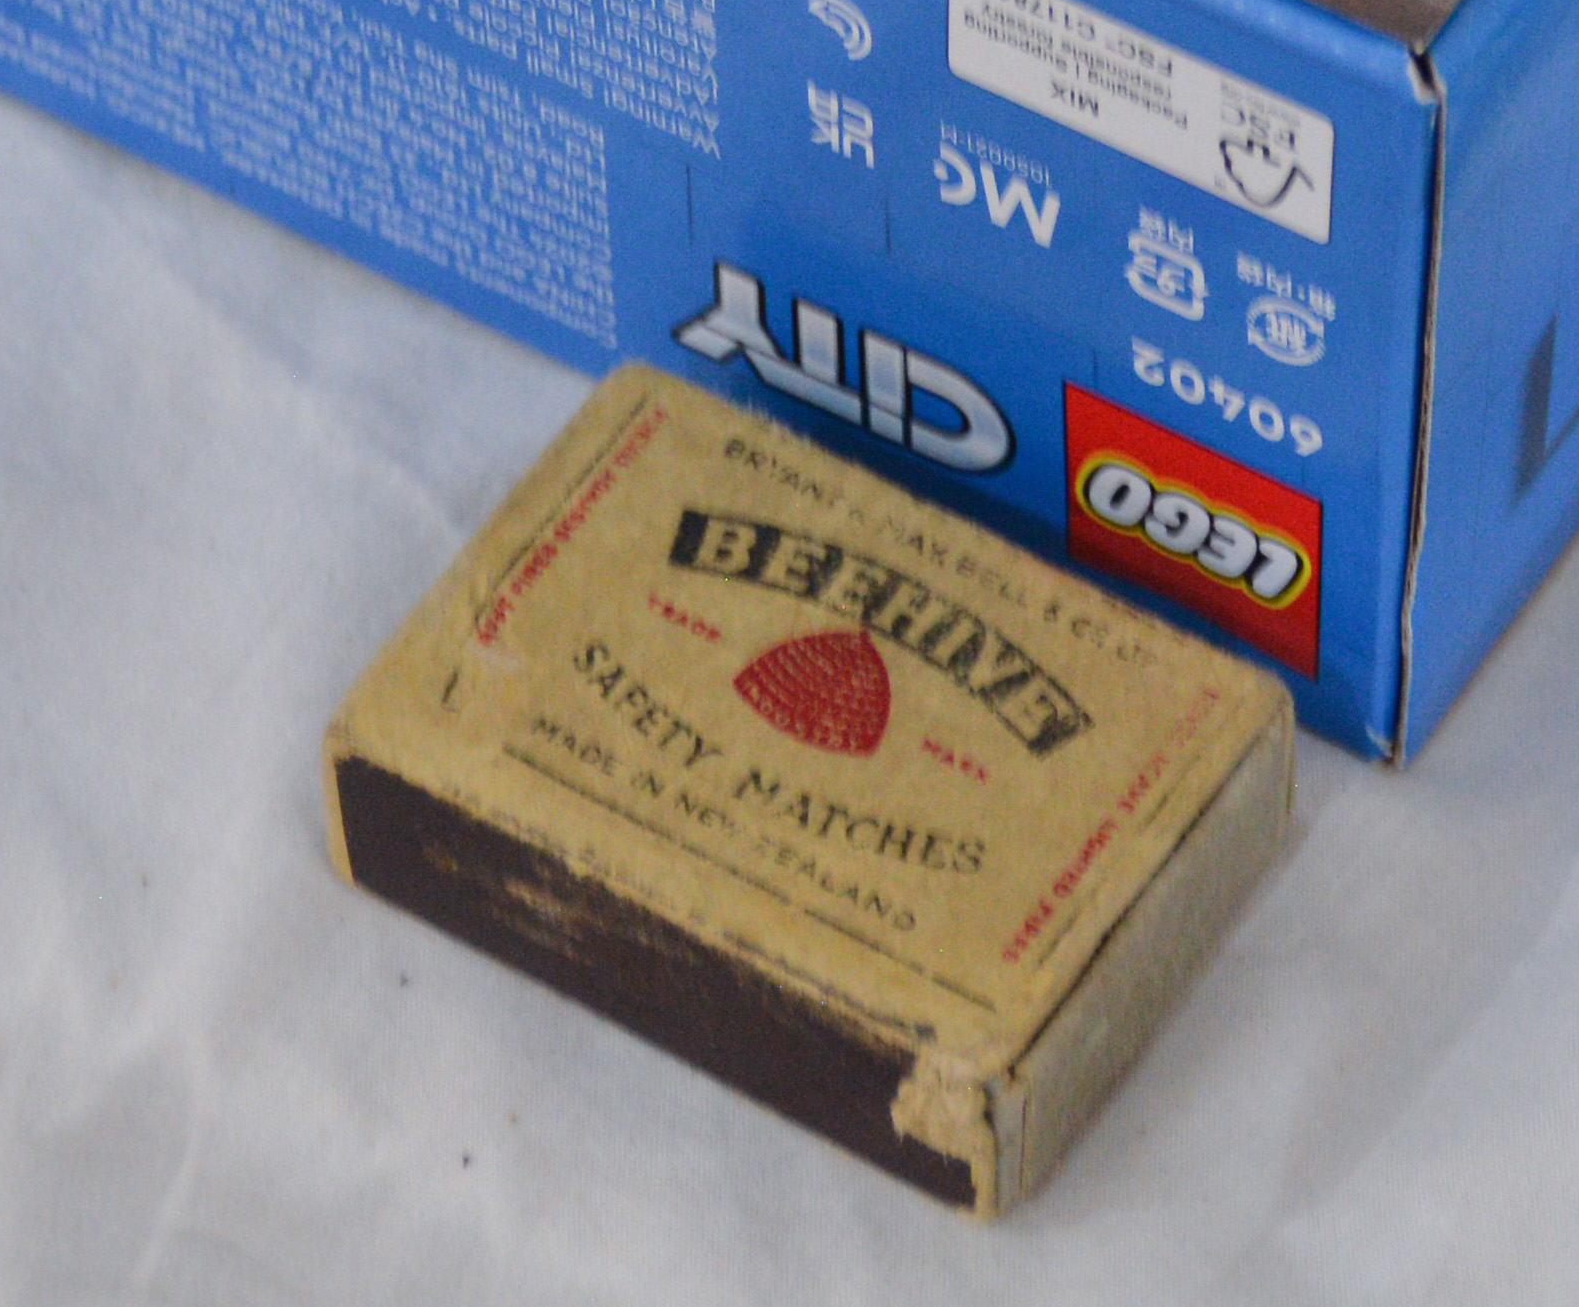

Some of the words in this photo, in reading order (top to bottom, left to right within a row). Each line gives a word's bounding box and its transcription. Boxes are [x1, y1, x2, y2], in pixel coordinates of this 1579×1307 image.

[1049, 78, 1100, 120] MIX
[668, 260, 1016, 477] CITY
[1131, 341, 1324, 465] 60402
[1086, 457, 1297, 602] LEGO
[690, 513, 1070, 751] BEEHIVE
[530, 713, 623, 777] MADE
[571, 638, 734, 772] SAFETY
[734, 761, 987, 879] MATCHES
